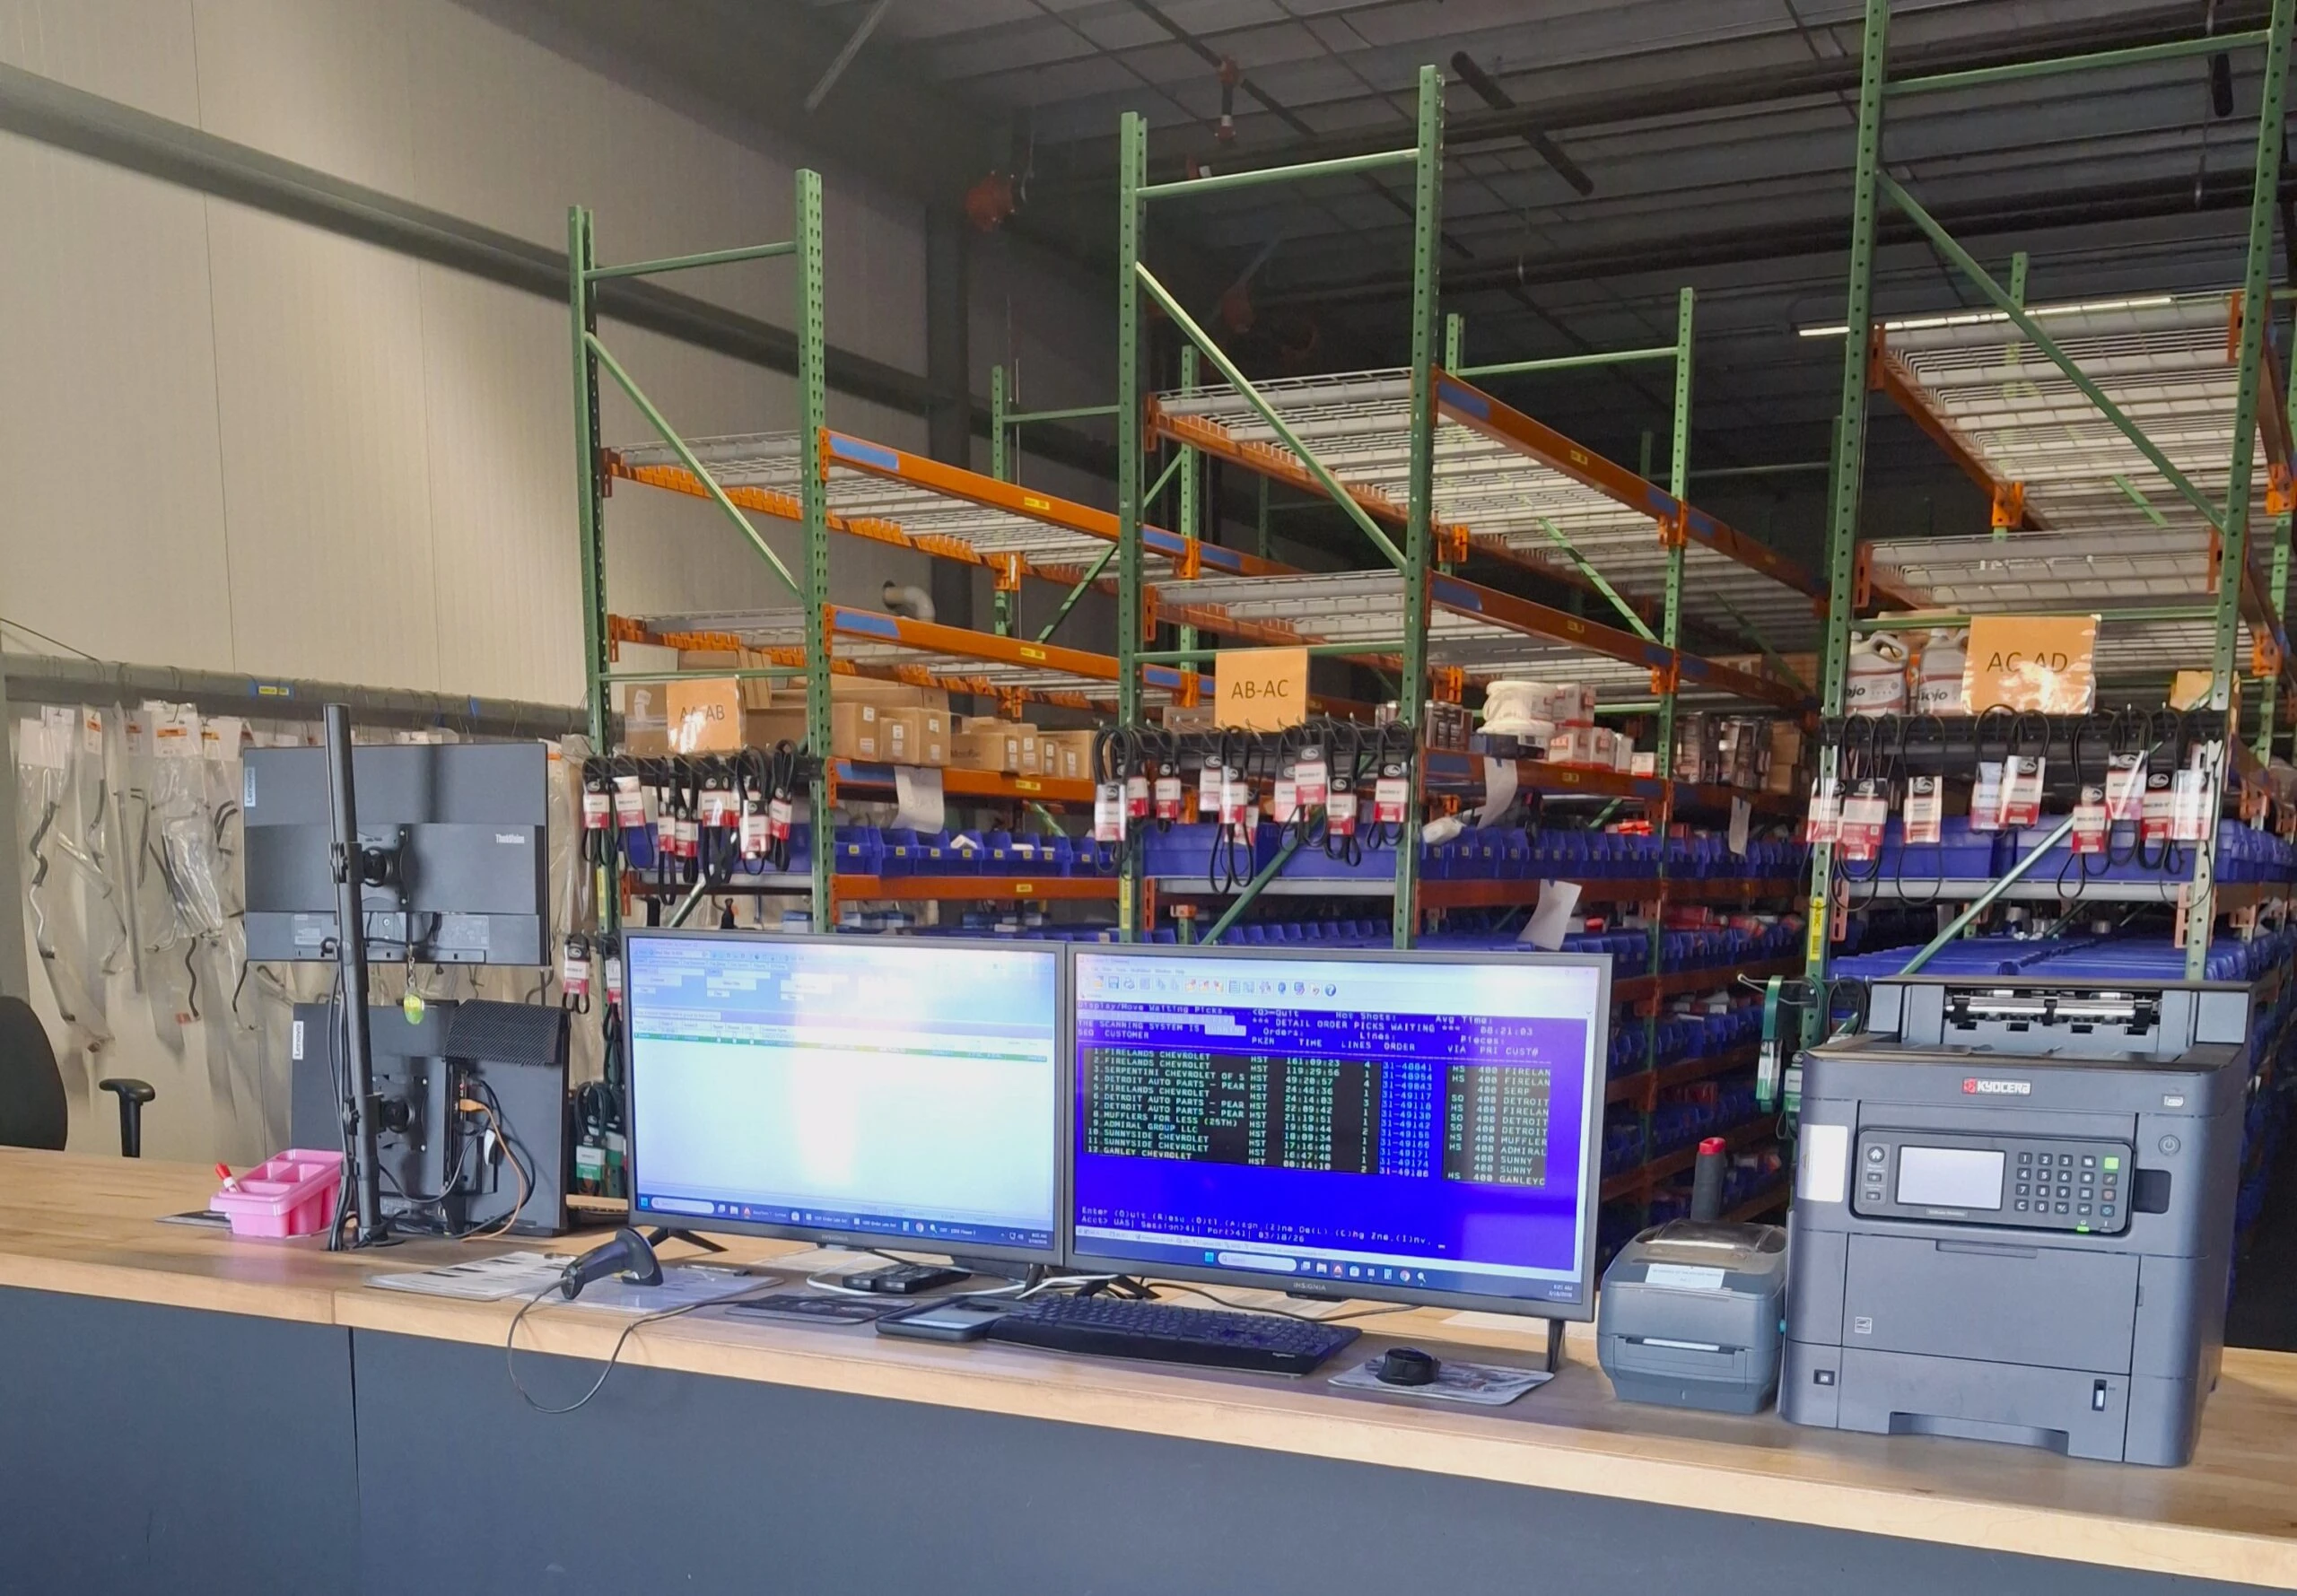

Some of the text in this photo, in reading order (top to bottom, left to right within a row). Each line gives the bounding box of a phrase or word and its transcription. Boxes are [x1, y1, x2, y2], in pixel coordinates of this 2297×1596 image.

[1987, 651, 2067, 673] ACAD
[1231, 679, 1288, 700] AB-AC
[246, 769, 254, 803] Lenovo
[495, 833, 525, 843] ThinkVision
[1148, 1005, 1188, 1014] Waiting
[1435, 1015, 1454, 1024] Avg
[1461, 1016, 1493, 1024] Time:
[1099, 1021, 1143, 1029] SCANNING
[1263, 1027, 1305, 1035] Orders:
[1359, 1032, 1396, 1040] Lines:
[1460, 1035, 1506, 1044] Pieces:
[1275, 1018, 1311, 1026] DETAIL
[1317, 1020, 1348, 1028] ORDER
[1391, 1023, 1435, 1031] WAITING
[1105, 1030, 1148, 1038] CUSTOMER
[1505, 1047, 1538, 1055] CUST#
[1159, 1051, 1210, 1060] CHEVROLET
[1504, 1068, 1550, 1076] FIRELAN
[1159, 1060, 1210, 1068] CHEVROLET
[1504, 1077, 1550, 1086] FIRELAN
[1165, 1069, 1216, 1078] CHEVROLET
[1977, 1080, 2031, 1095] KYOCERA
[1158, 1087, 1210, 1096] CHEVROLET
[1502, 1107, 1548, 1116] FIRELAN
[1382, 1090, 1432, 1099] 31-49117
[1502, 1097, 1549, 1106] DETROIT
[1221, 1100, 1244, 1108] PEAR
[1501, 1117, 1548, 1126] DETROIT
[1147, 1123, 1175, 1131] GROUP
[1500, 1146, 1546, 1156] ADMIRAL
[1501, 1127, 1547, 1136] DETROIT
[1158, 1133, 1209, 1142] CHEVROLET
[1499, 1156, 1533, 1164] SUNNY
[1500, 1136, 1547, 1146] MUFFLER
[1141, 1150, 1192, 1159] CHEVROLET
[1158, 1142, 1209, 1151] CHEVROLET
[1499, 1165, 1532, 1174] SUNNY
[2042, 1156, 2048, 1164] 2
[2021, 1170, 2027, 1178] 4
[2061, 1173, 2067, 1181] 6
[2039, 1187, 2046, 1195] 8
[2039, 1203, 2045, 1211] 0
[1293, 1282, 1326, 1291] INSIGNIA
